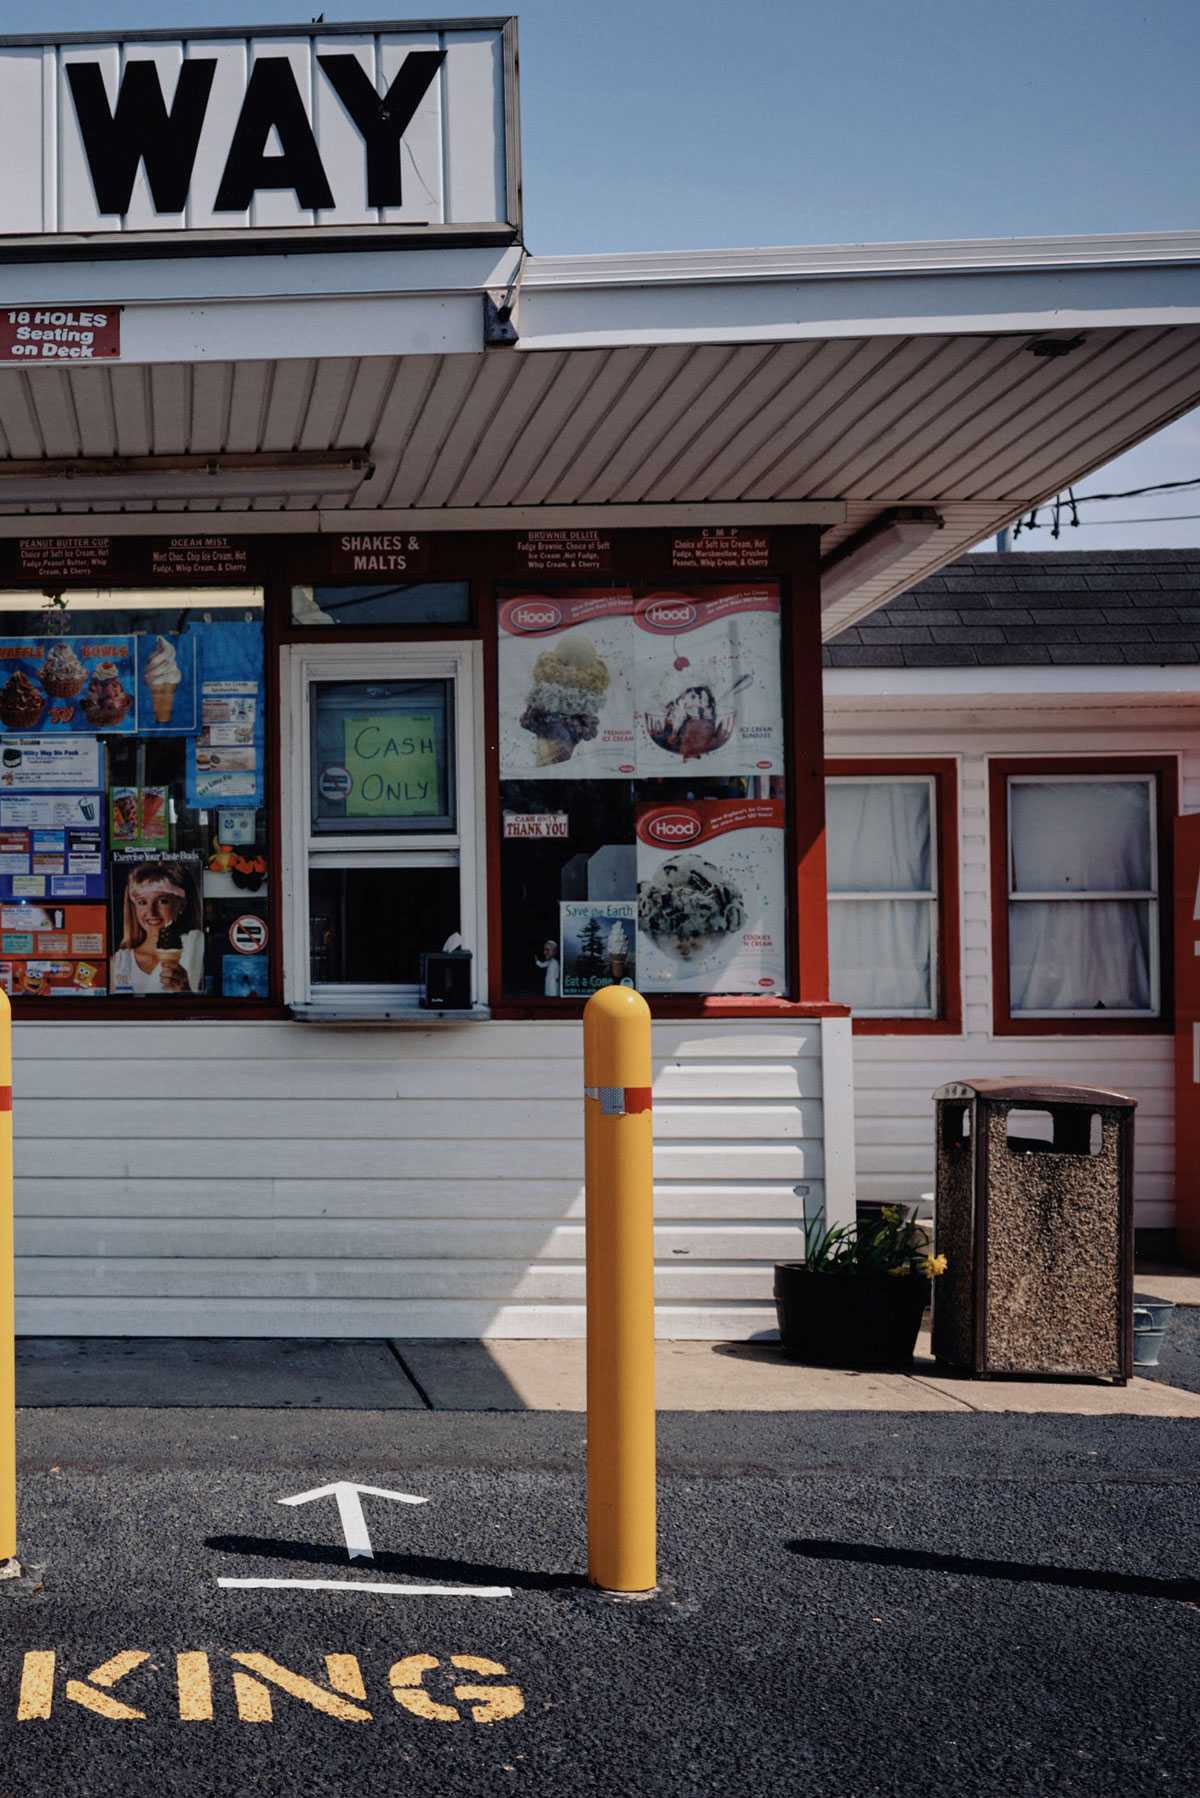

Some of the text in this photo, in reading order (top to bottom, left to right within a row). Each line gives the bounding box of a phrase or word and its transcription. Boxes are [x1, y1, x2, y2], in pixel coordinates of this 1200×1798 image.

[64, 50, 448, 214] WAY
[8, 312, 107, 326] 18 HOLES
[16, 326, 95, 345] Seating
[11, 344, 95, 357] on Deck
[171, 538, 227, 546] OCEAN MIST
[341, 536, 420, 551] SHAKES &
[353, 556, 406, 570] MALTS
[518, 611, 554, 623] Hood
[652, 608, 690, 620] Hood
[354, 726, 434, 759] CASH
[360, 774, 428, 802] ONLY
[507, 823, 566, 835] THANK YOU
[656, 822, 694, 835] Hood
[566, 905, 589, 916] Save
[607, 904, 633, 916] Earth
